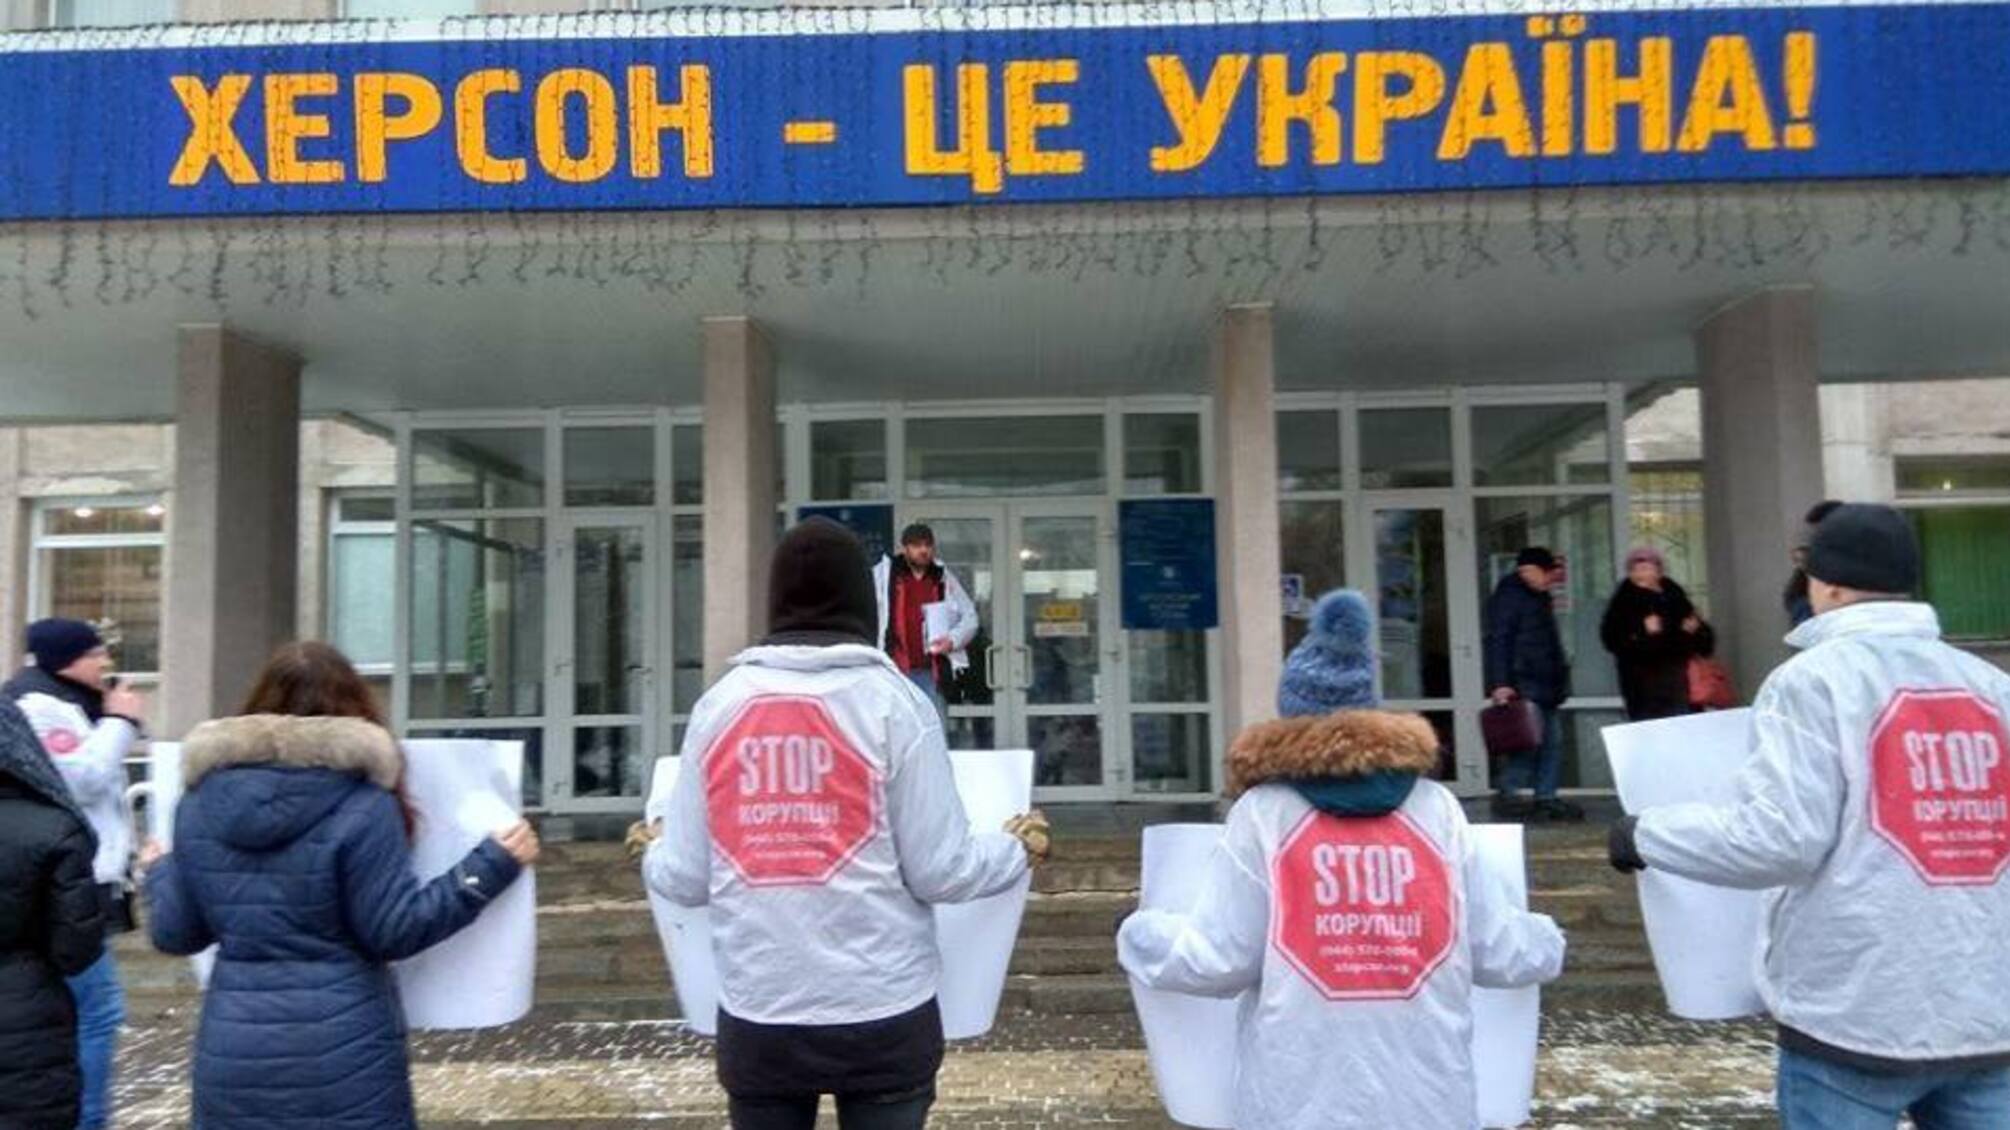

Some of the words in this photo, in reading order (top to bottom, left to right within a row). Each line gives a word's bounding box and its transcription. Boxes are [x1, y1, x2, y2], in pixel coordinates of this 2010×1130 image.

[169, 65, 713, 187] ХЕРСОН
[904, 60, 1084, 193] ЦЕ
[1147, 14, 1817, 173] УКРАЇНА!
[737, 734, 835, 796] STOP
[1904, 730, 1999, 791] STOP
[1312, 843, 1415, 906] STOP
[1315, 910, 1423, 941] КОРУПЦІЇ
